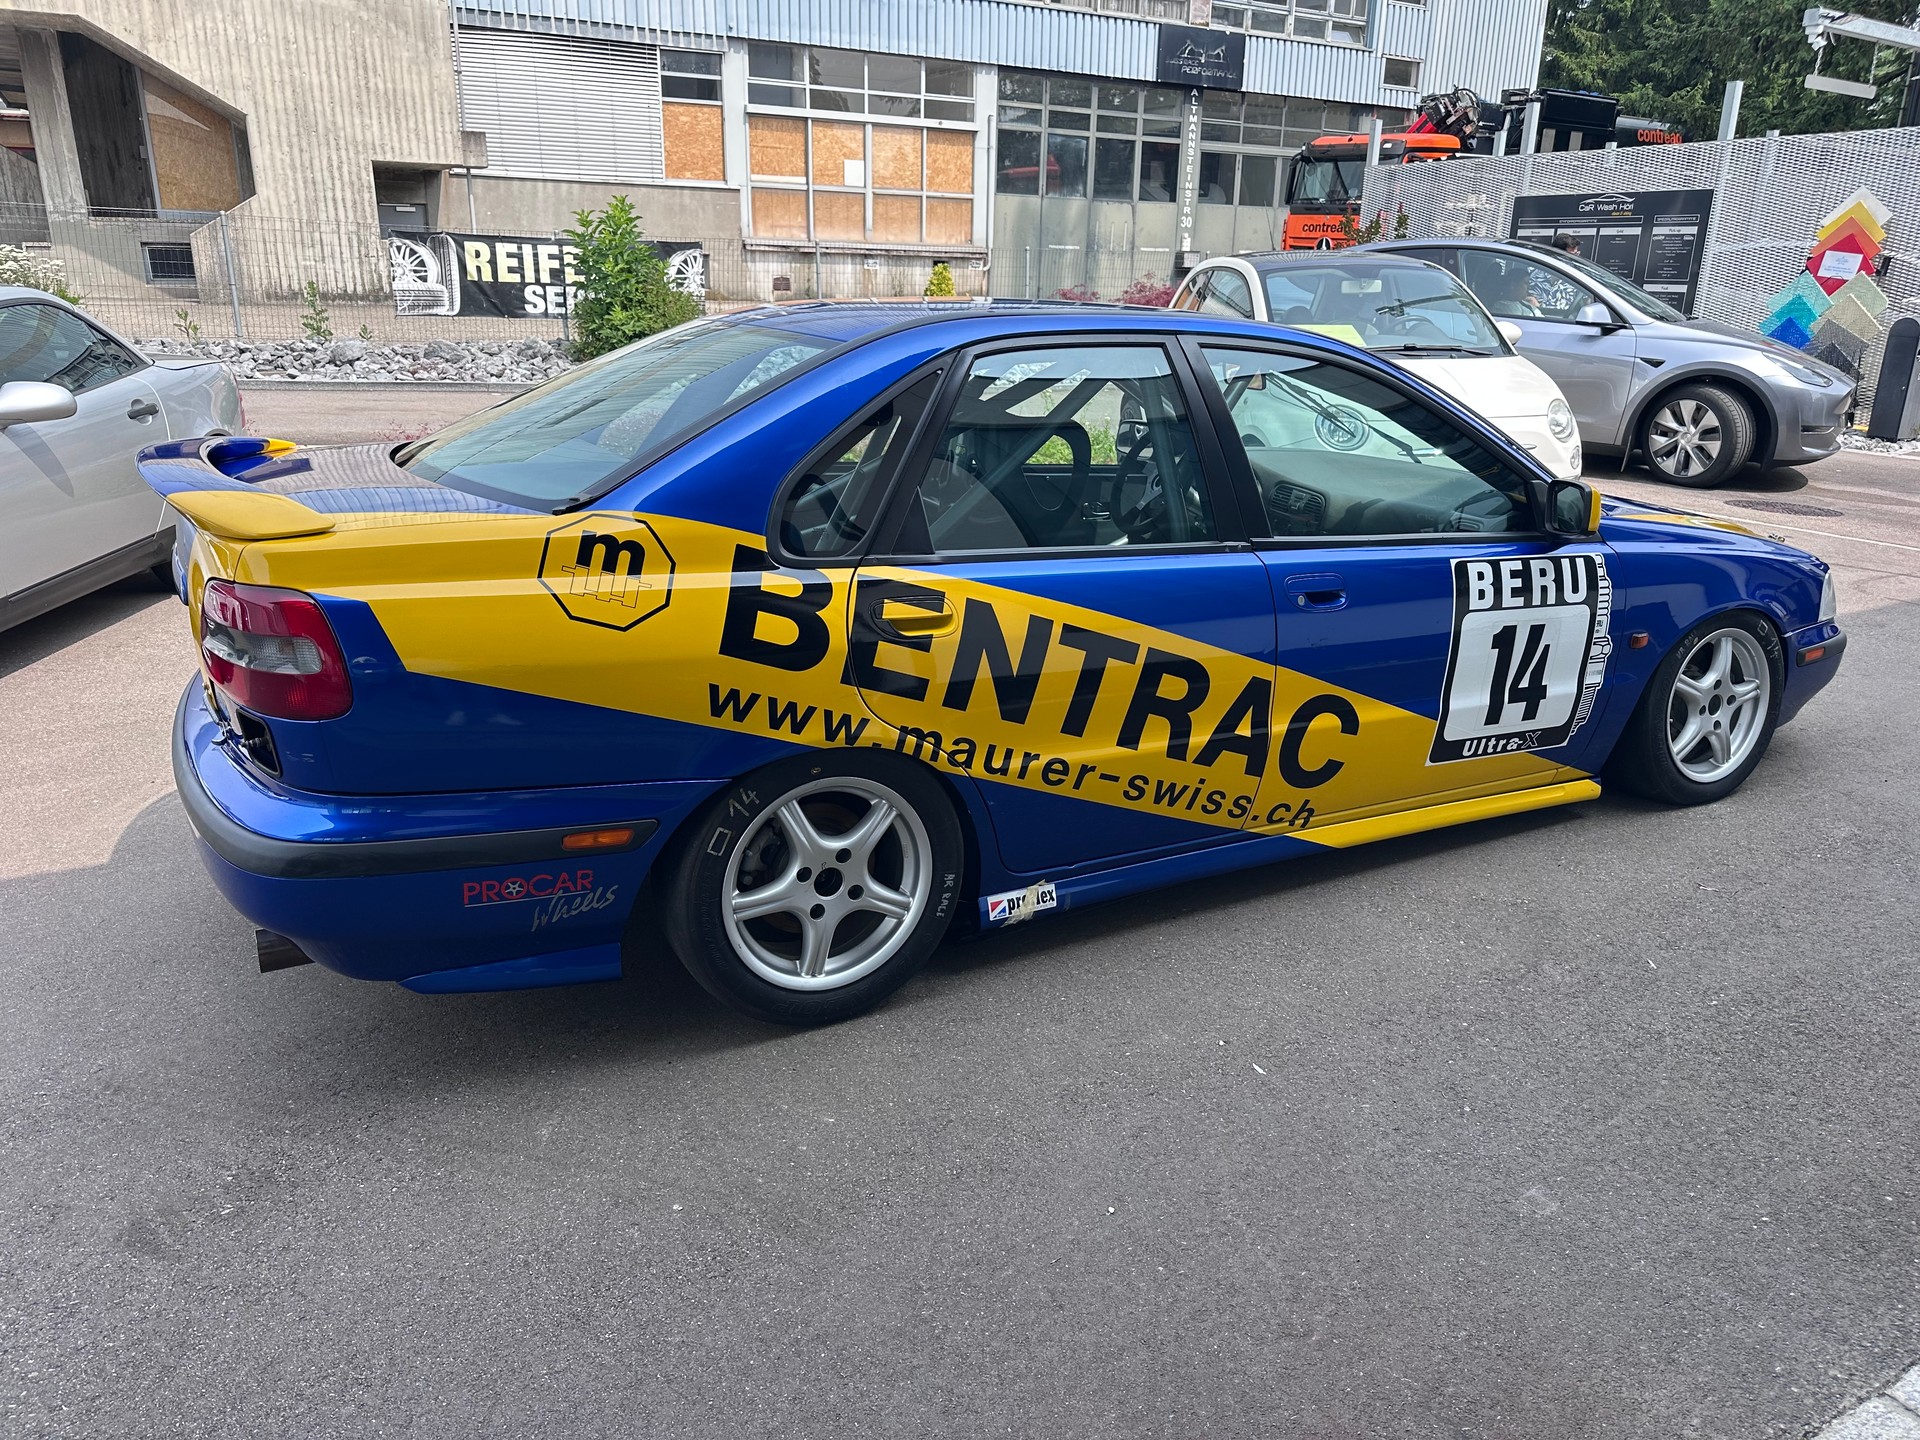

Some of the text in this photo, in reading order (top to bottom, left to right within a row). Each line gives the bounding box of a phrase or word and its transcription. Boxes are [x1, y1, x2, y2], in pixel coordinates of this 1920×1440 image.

[1180, 215, 1193, 228] 30
[1302, 222, 1344, 233] contrea
[1596, 203, 1618, 211] Wash
[463, 241, 586, 284] REIFE
[1466, 557, 1588, 611] BERU
[719, 543, 1361, 789] BENTRAC
[1483, 623, 1548, 727] 14
[708, 682, 1316, 829] www.maurer-swiss.ch
[463, 869, 594, 905] PROCAR
